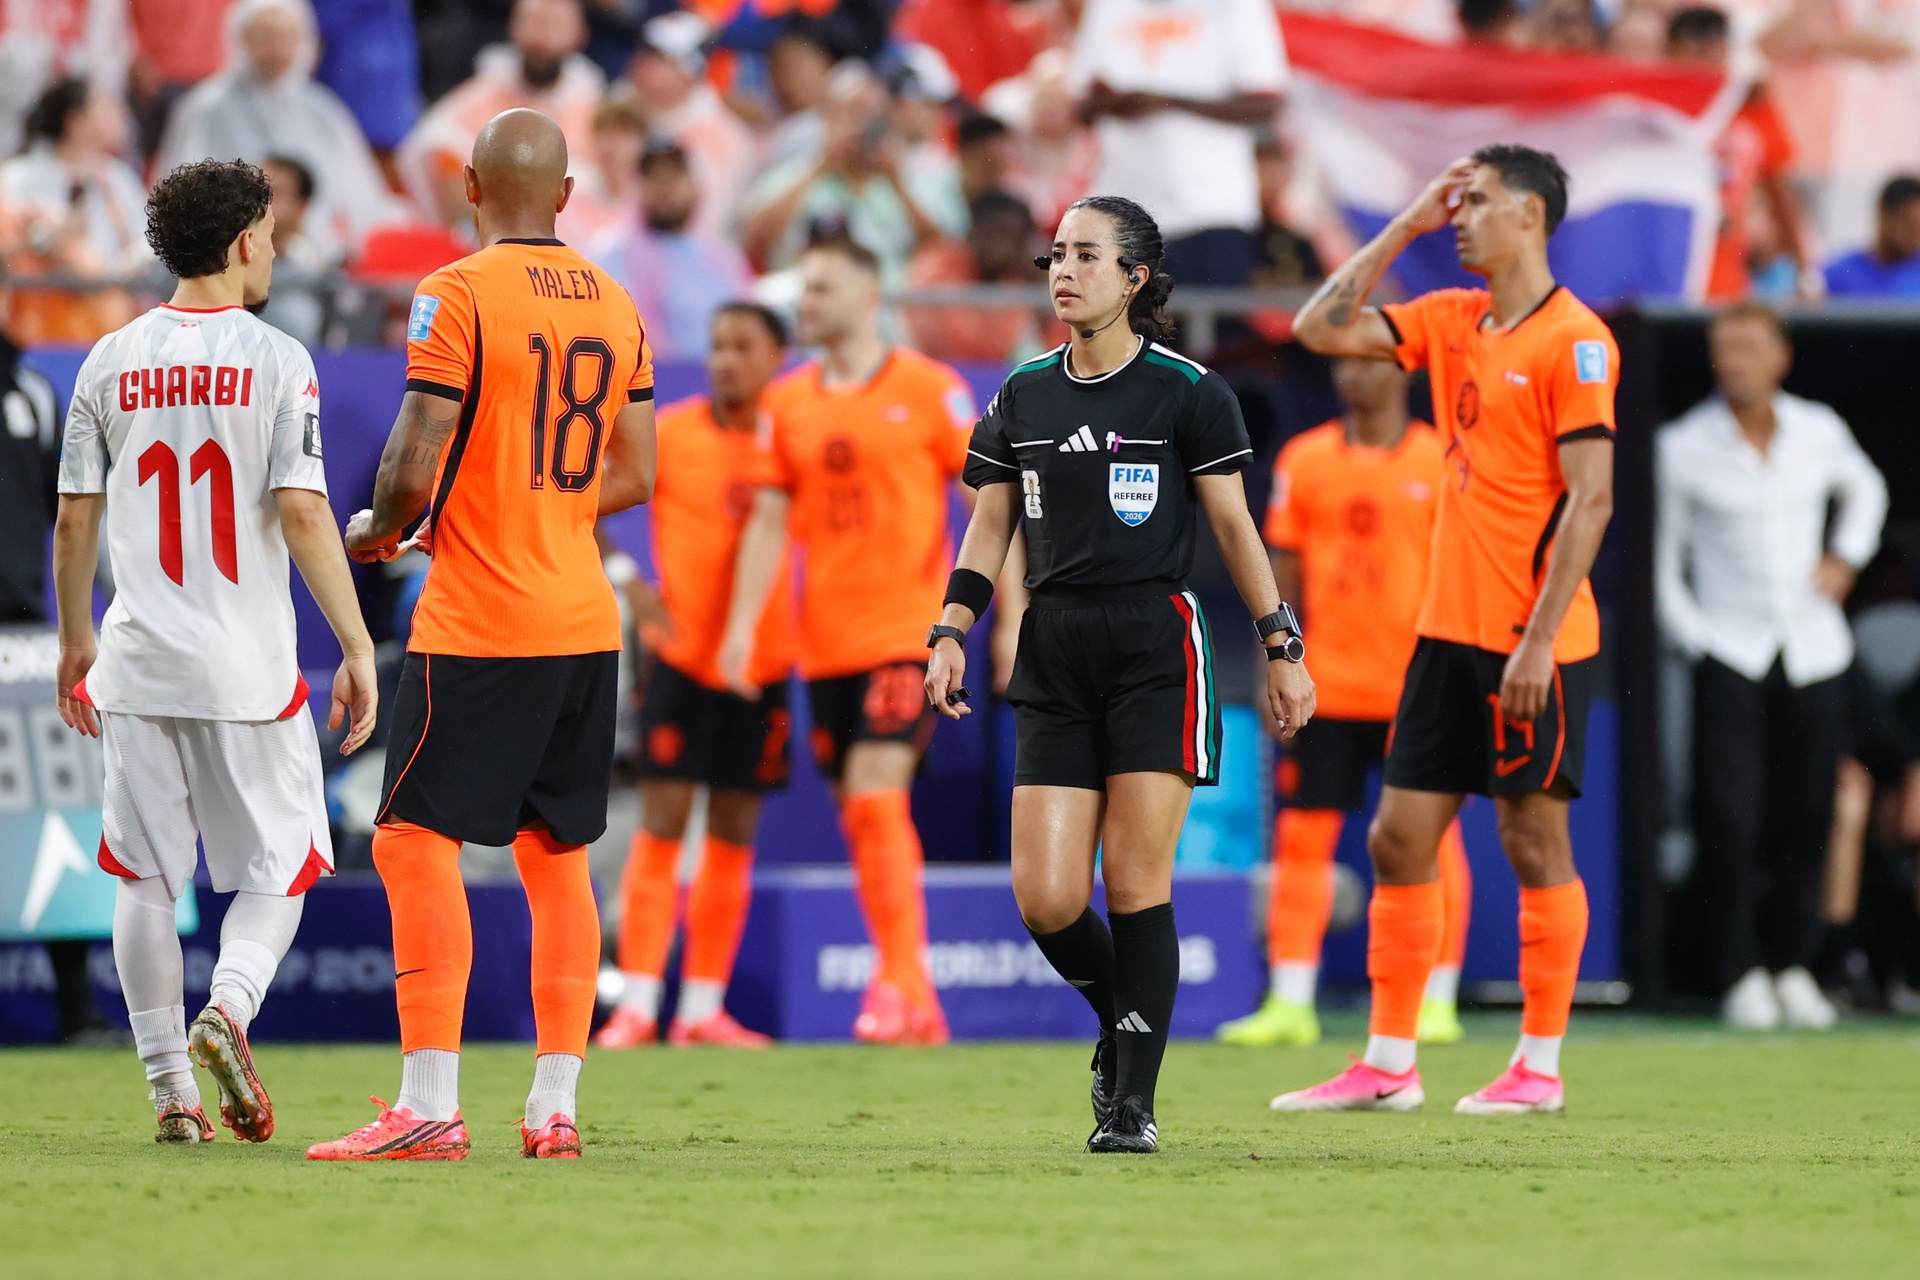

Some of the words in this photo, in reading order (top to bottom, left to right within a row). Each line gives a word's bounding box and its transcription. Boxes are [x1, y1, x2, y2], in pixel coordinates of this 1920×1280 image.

[525, 266, 600, 301] MALEN
[119, 365, 253, 412] GHARBI
[528, 333, 616, 493] 18
[1114, 467, 1155, 483] FIFA
[137, 438, 239, 588] 11
[1113, 492, 1154, 501] REFEREE
[1124, 512, 1143, 520] 2026
